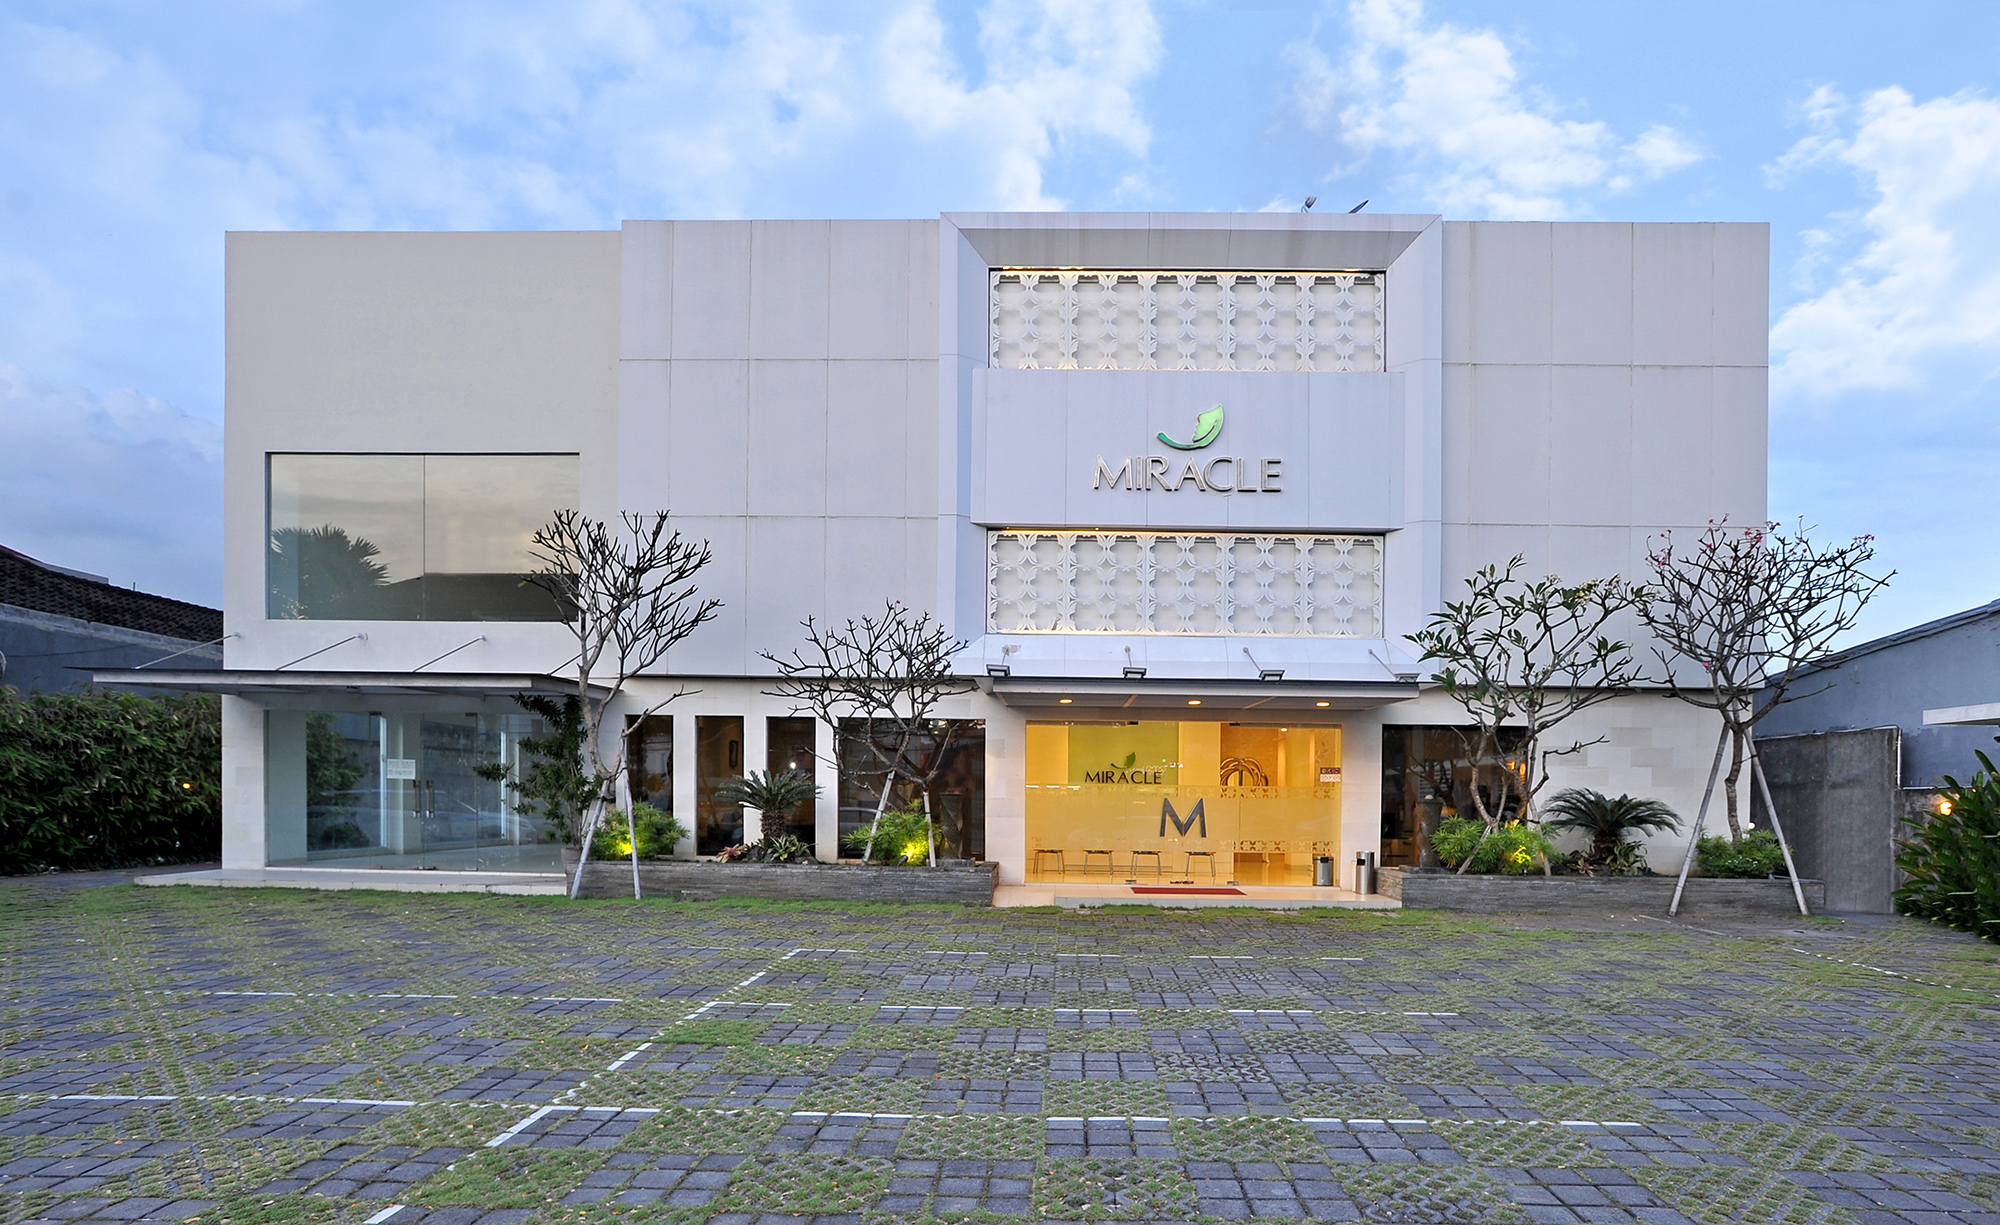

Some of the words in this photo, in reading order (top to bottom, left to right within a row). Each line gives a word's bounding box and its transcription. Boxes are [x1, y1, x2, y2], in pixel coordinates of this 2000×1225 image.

[1093, 455, 1282, 492] MIRACLE
[1085, 770, 1162, 785] MIRACLE
[1159, 797, 1207, 838] M
